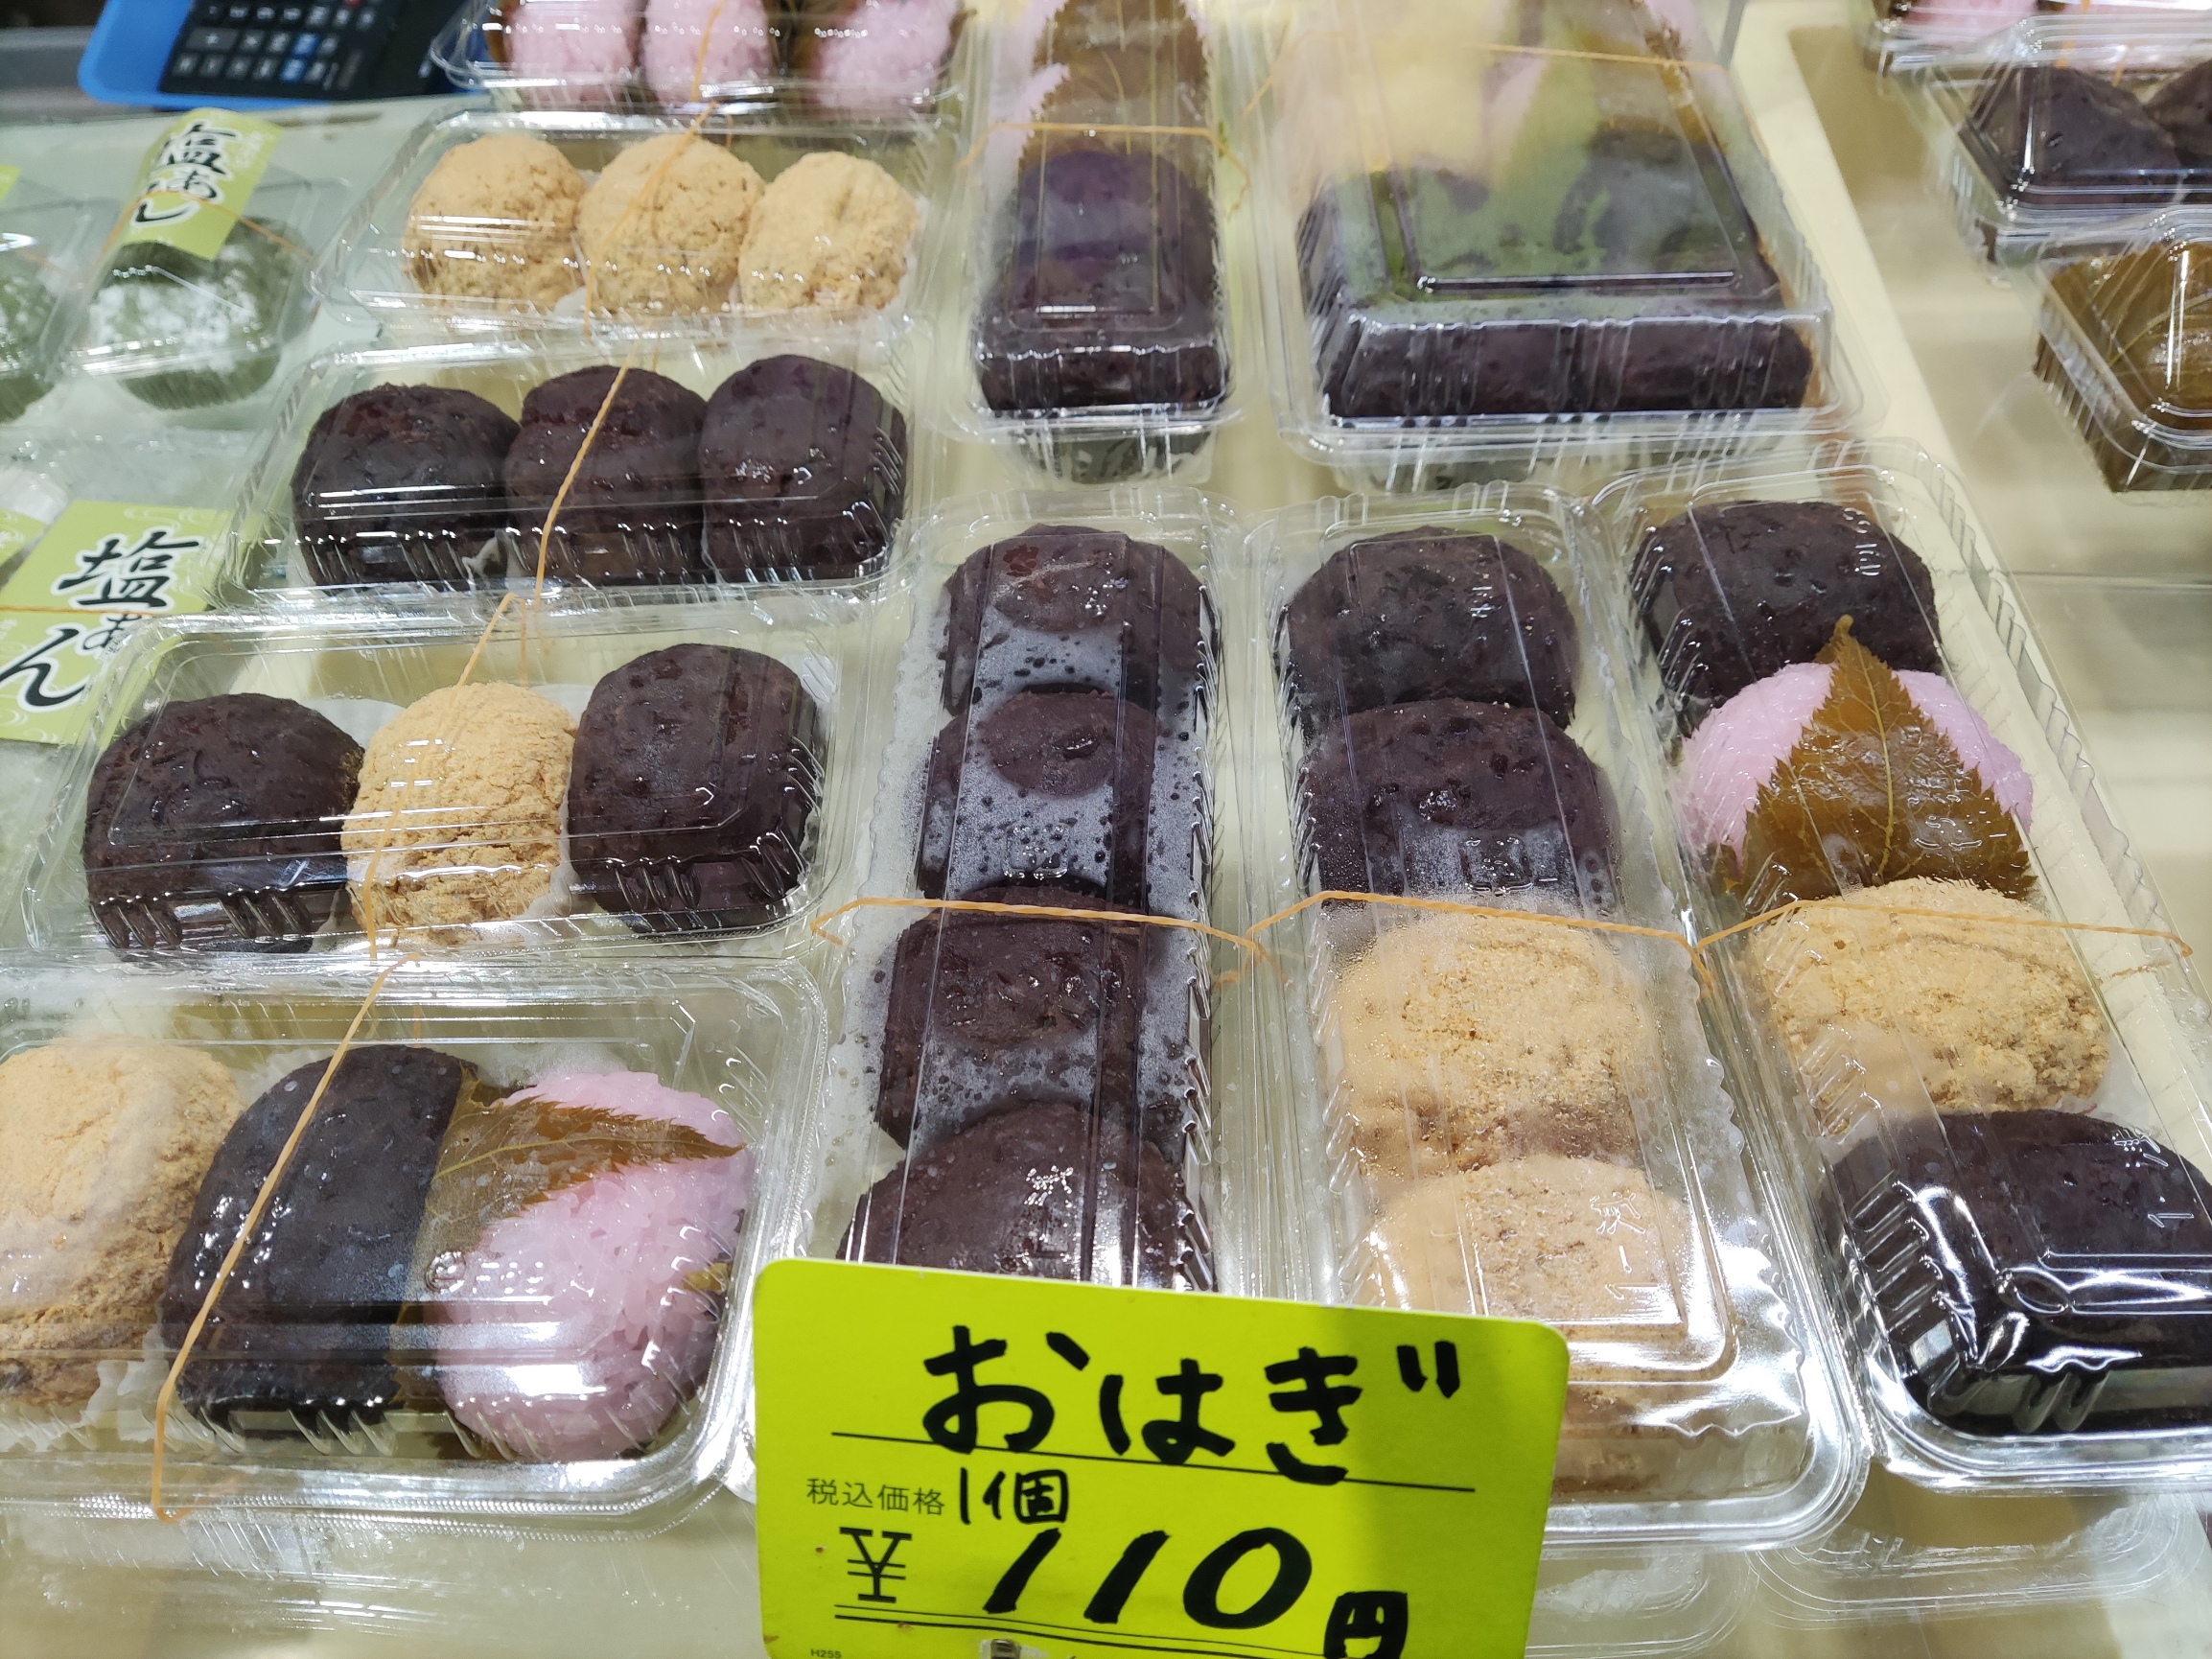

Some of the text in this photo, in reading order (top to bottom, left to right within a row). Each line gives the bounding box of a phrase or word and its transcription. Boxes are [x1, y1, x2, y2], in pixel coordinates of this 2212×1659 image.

[923, 1325, 1459, 1485] おはぎ
[806, 1478, 945, 1516] 税込価格
[960, 1467, 1069, 1525] 1個
